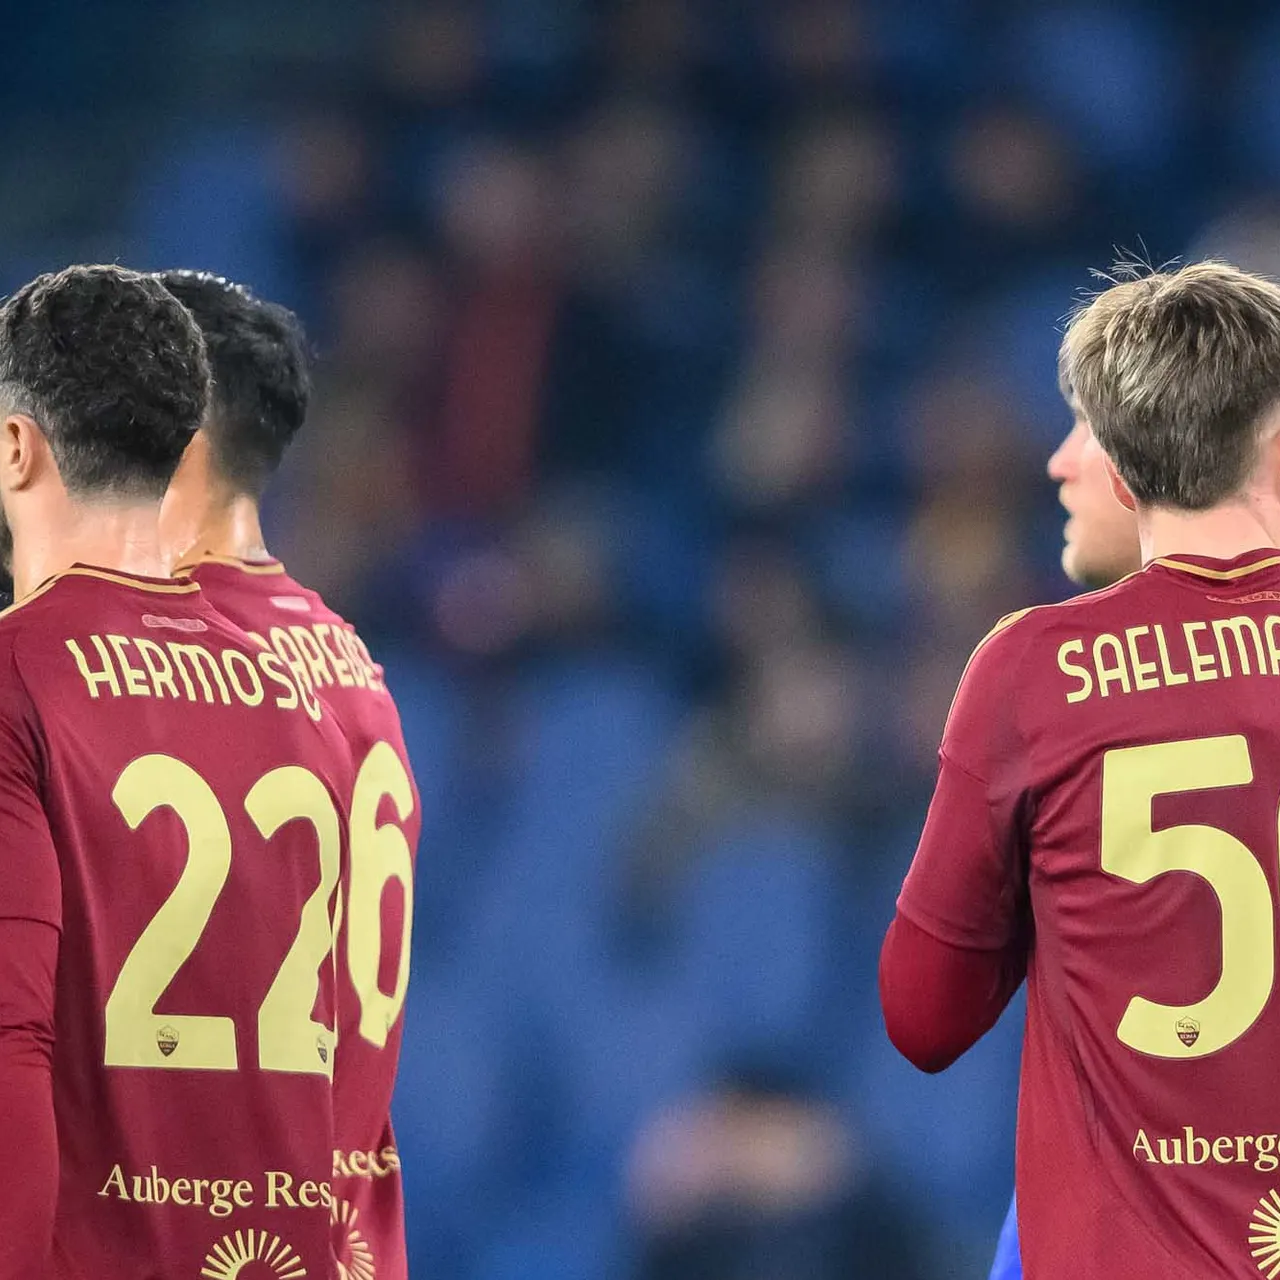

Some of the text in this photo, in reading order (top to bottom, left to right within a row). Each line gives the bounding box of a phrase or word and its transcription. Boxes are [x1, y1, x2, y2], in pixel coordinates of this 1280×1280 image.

[103, 753, 342, 1078] 22
[330, 740, 415, 1051] 6
[97, 1164, 254, 1217] Auberge
